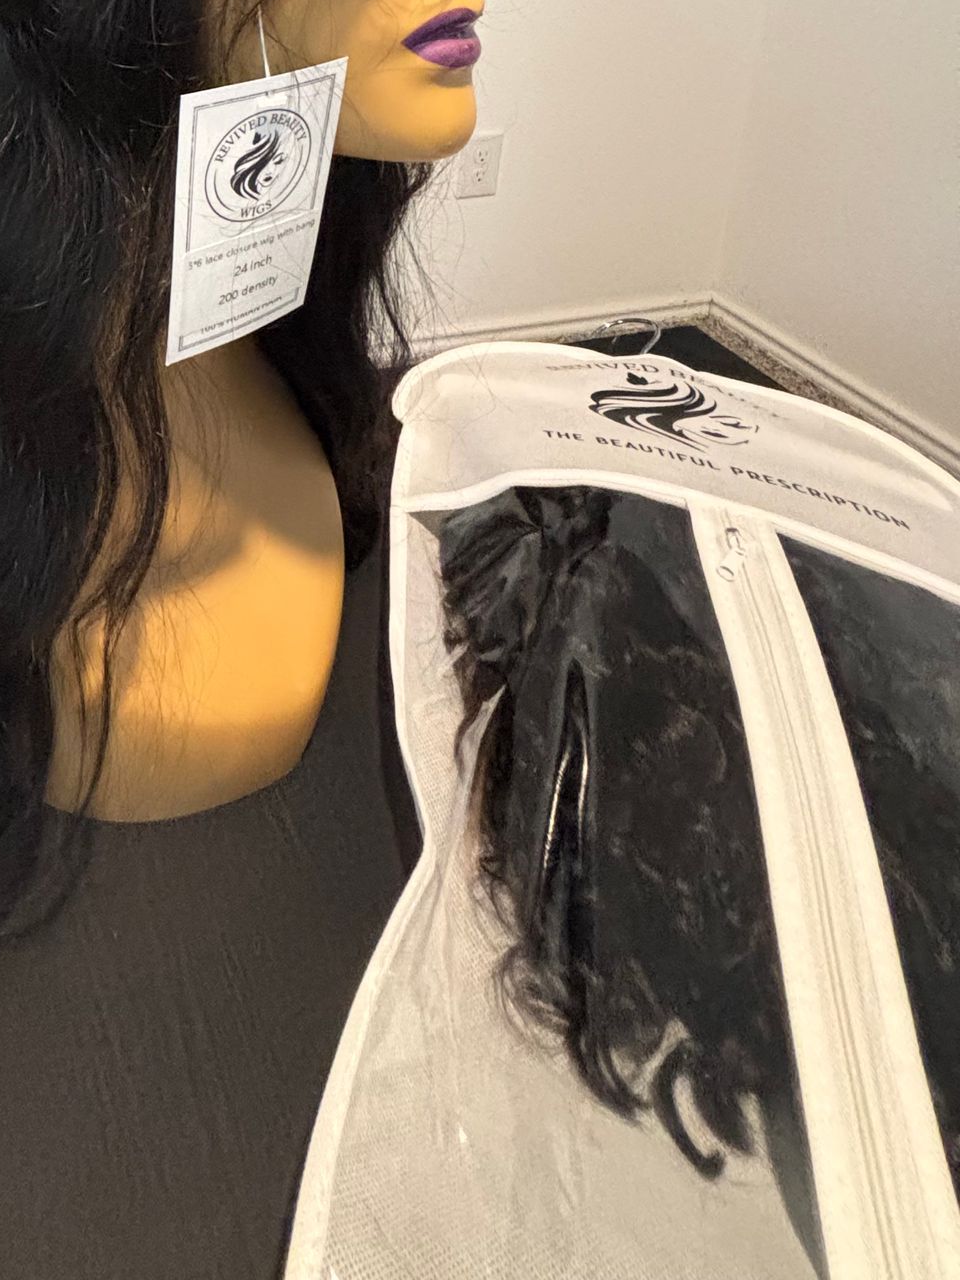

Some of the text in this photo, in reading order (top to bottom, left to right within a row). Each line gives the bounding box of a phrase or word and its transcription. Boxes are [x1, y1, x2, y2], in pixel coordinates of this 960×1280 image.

[214, 113, 307, 163] REVIVED BEAUTY
[240, 200, 273, 219] WIGS
[205, 253, 223, 265] lace
[226, 241, 258, 258] closure
[260, 235, 275, 246] wig
[233, 255, 273, 277] 24 inch
[218, 276, 279, 305] 200 density
[543, 429, 911, 531] THE BEAUTIFUL PRESCRIPTION
